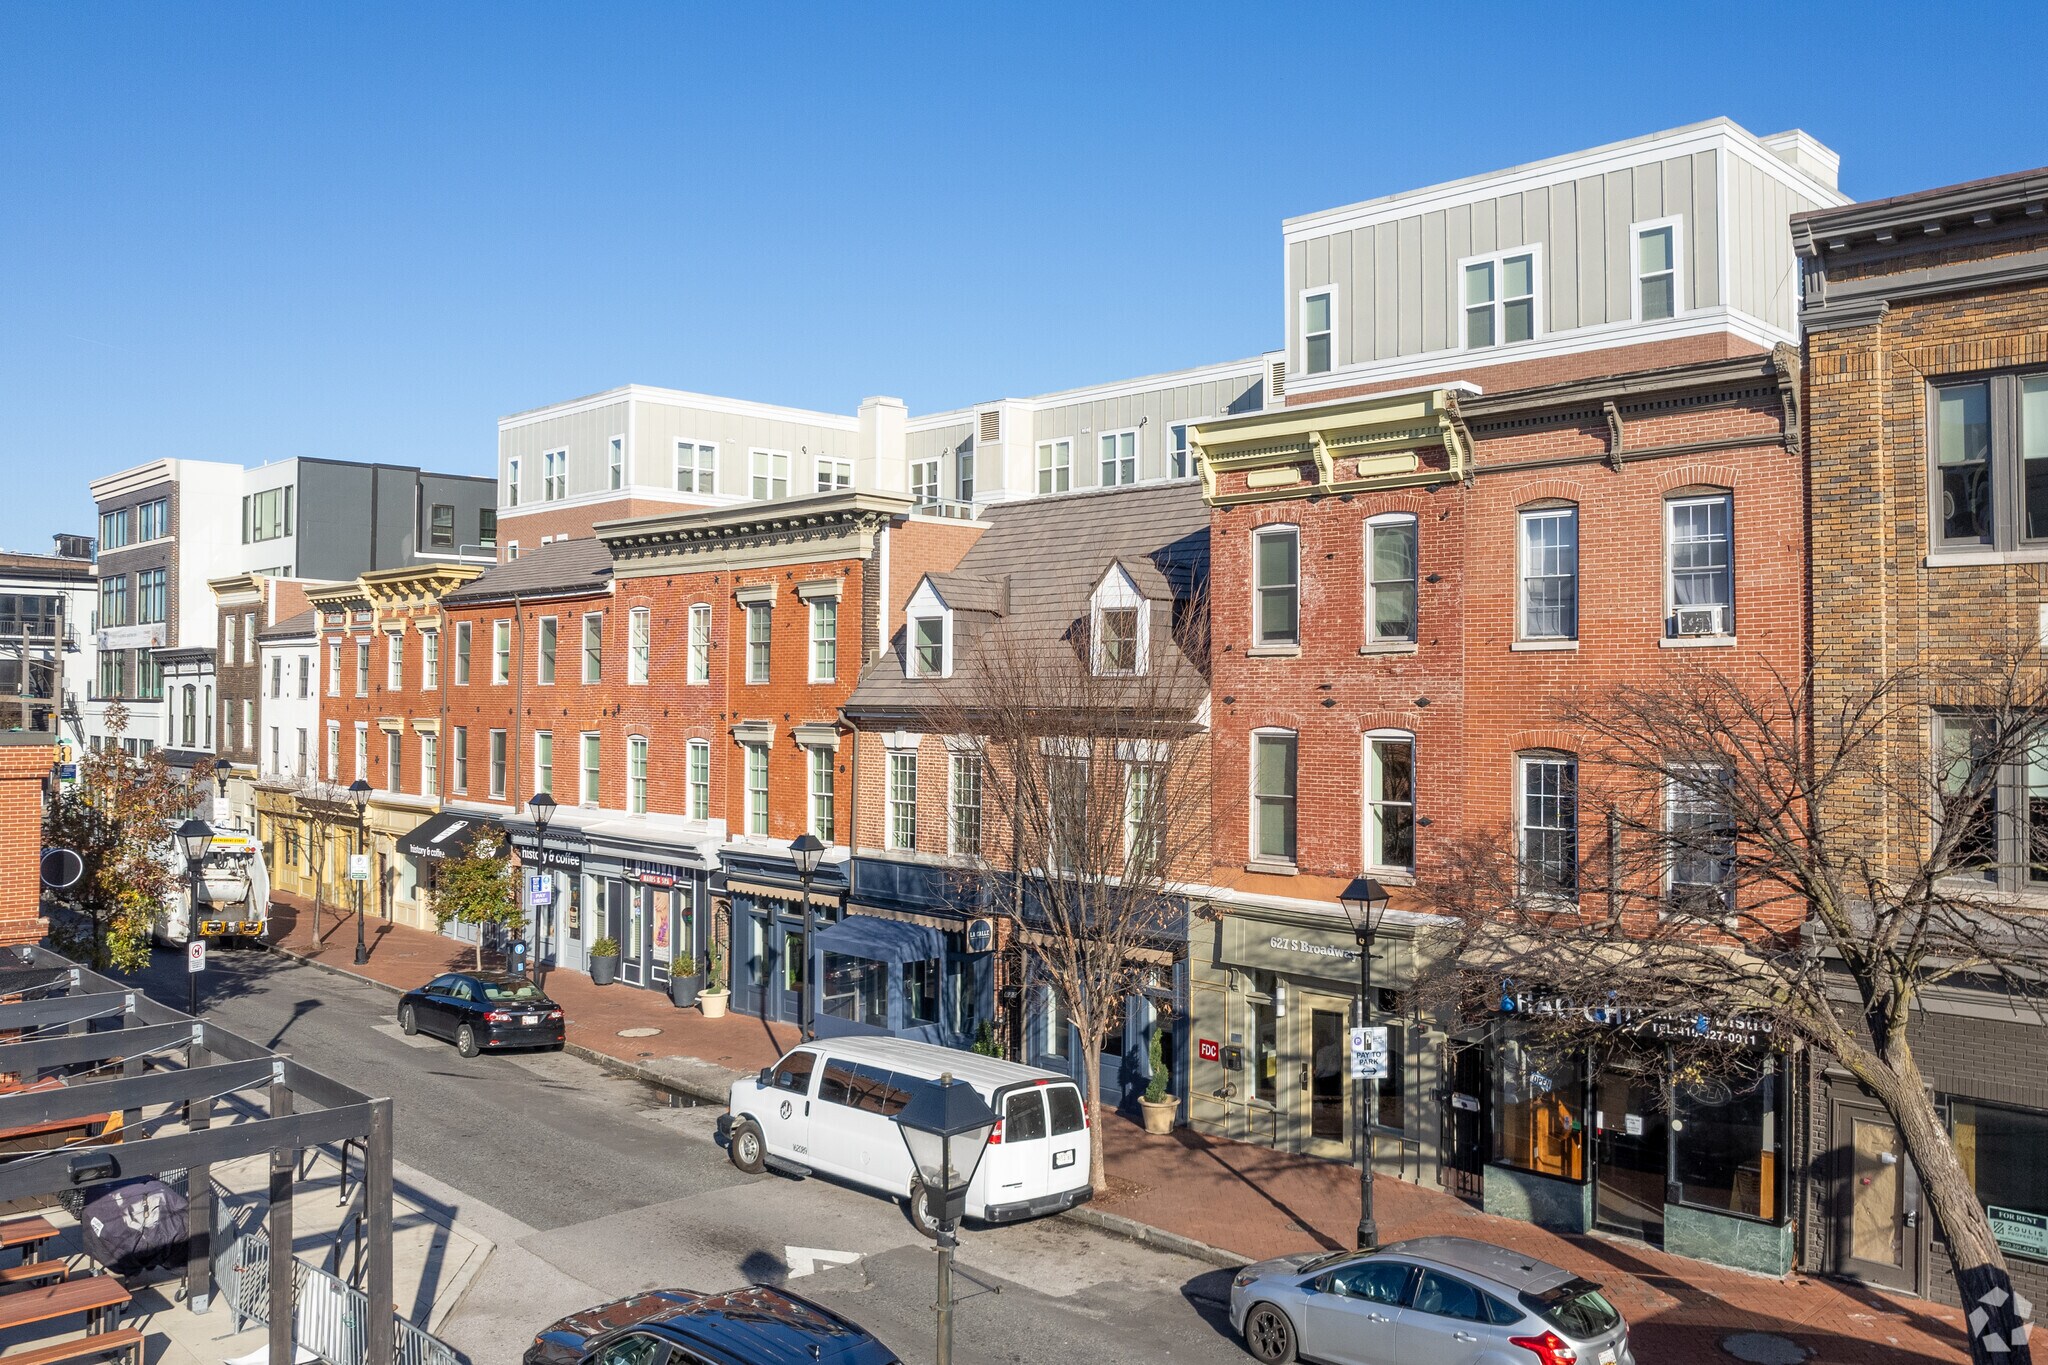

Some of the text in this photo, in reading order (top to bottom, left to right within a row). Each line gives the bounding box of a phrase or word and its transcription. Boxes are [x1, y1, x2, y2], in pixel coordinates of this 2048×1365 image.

[410, 844, 426, 857] history
[431, 848, 445, 858] coffee
[521, 846, 580, 866] histoy & coffee
[1270, 936, 1362, 963] 627 S Broadway
[1201, 1043, 1217, 1057] FDC
[1356, 1051, 1370, 1059] PAY
[1359, 1058, 1379, 1066] PARK
[1532, 1074, 1552, 1090] OPEN
[1690, 1083, 1726, 1101] OPEN
[1998, 1211, 2038, 1225] FOR RENT
[2007, 1224, 2043, 1237] ZOULIS
[2007, 1231, 2044, 1242] PROPERTIES
